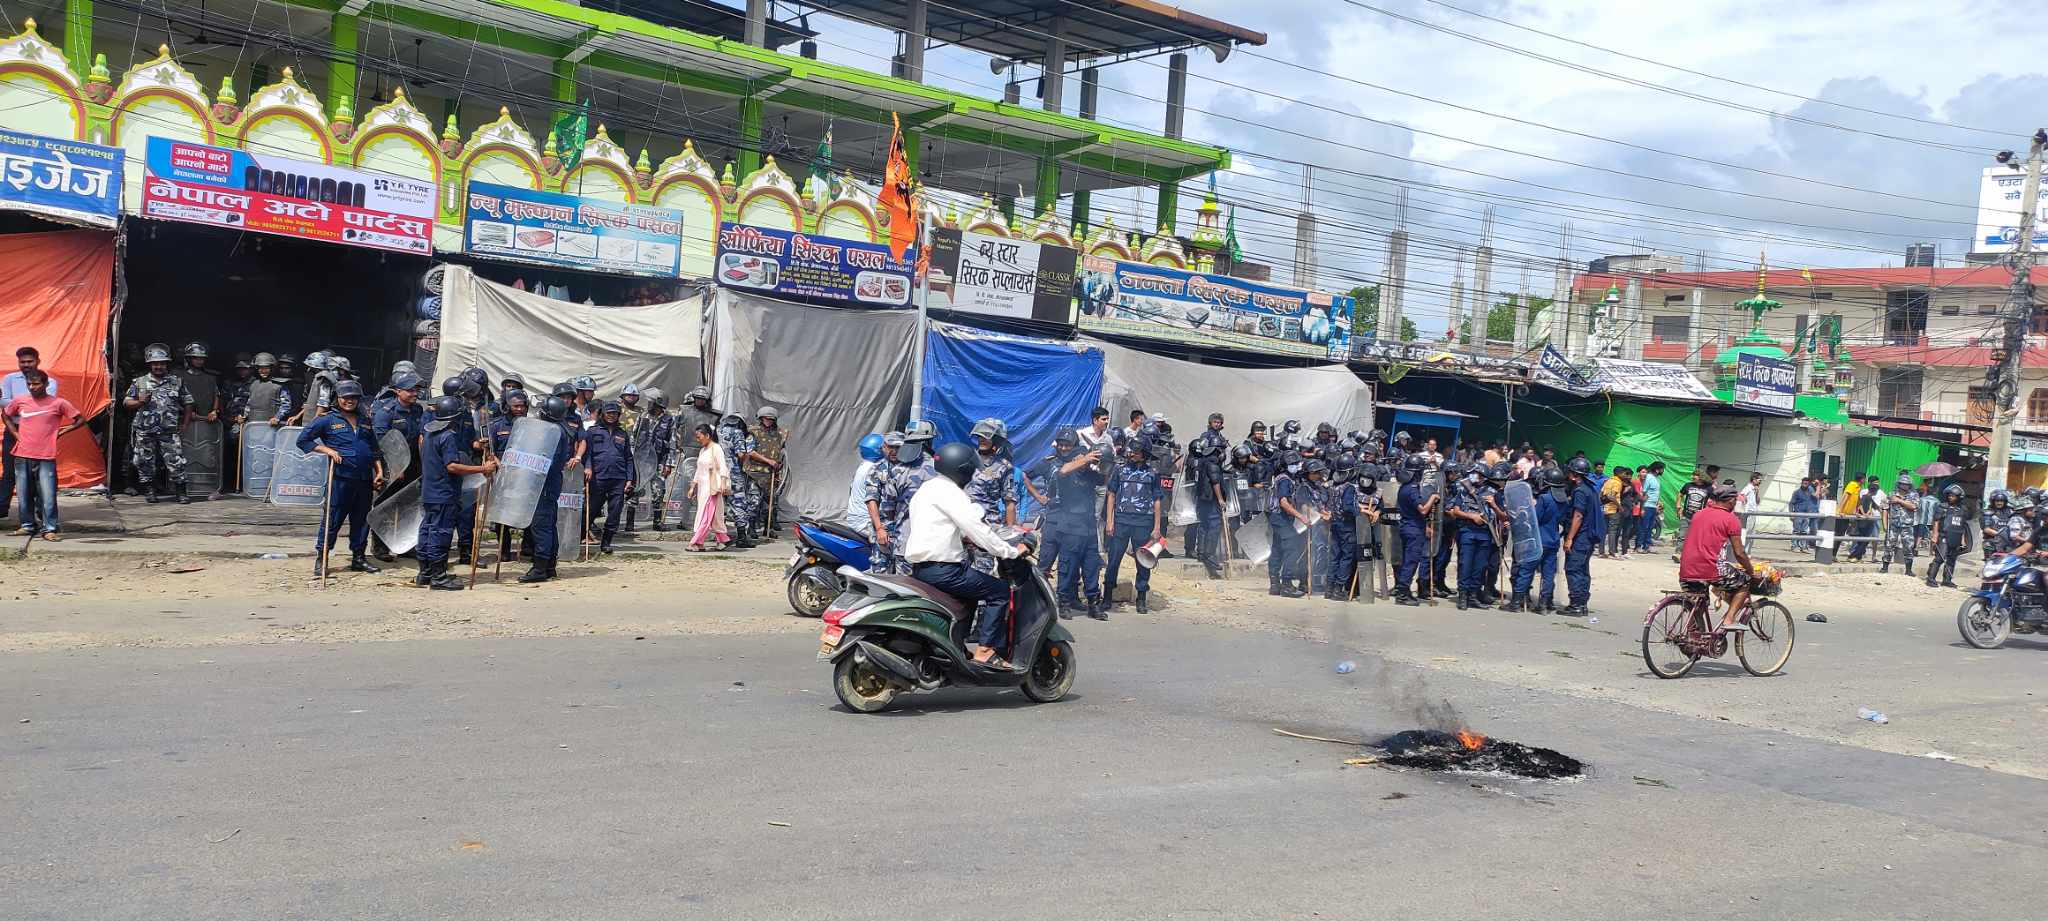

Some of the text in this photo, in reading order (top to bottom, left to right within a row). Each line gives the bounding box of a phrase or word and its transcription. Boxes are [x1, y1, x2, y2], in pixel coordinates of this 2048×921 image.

[149, 179, 252, 210] नेपाल
[264, 198, 332, 221] अटो
[720, 225, 888, 271] सोफिया सिरक पसल
[997, 243, 1020, 265] स्टार
[961, 259, 990, 286] सिरक
[991, 269, 1036, 294] सप्लायर्स
[279, 485, 321, 496] POLICE
